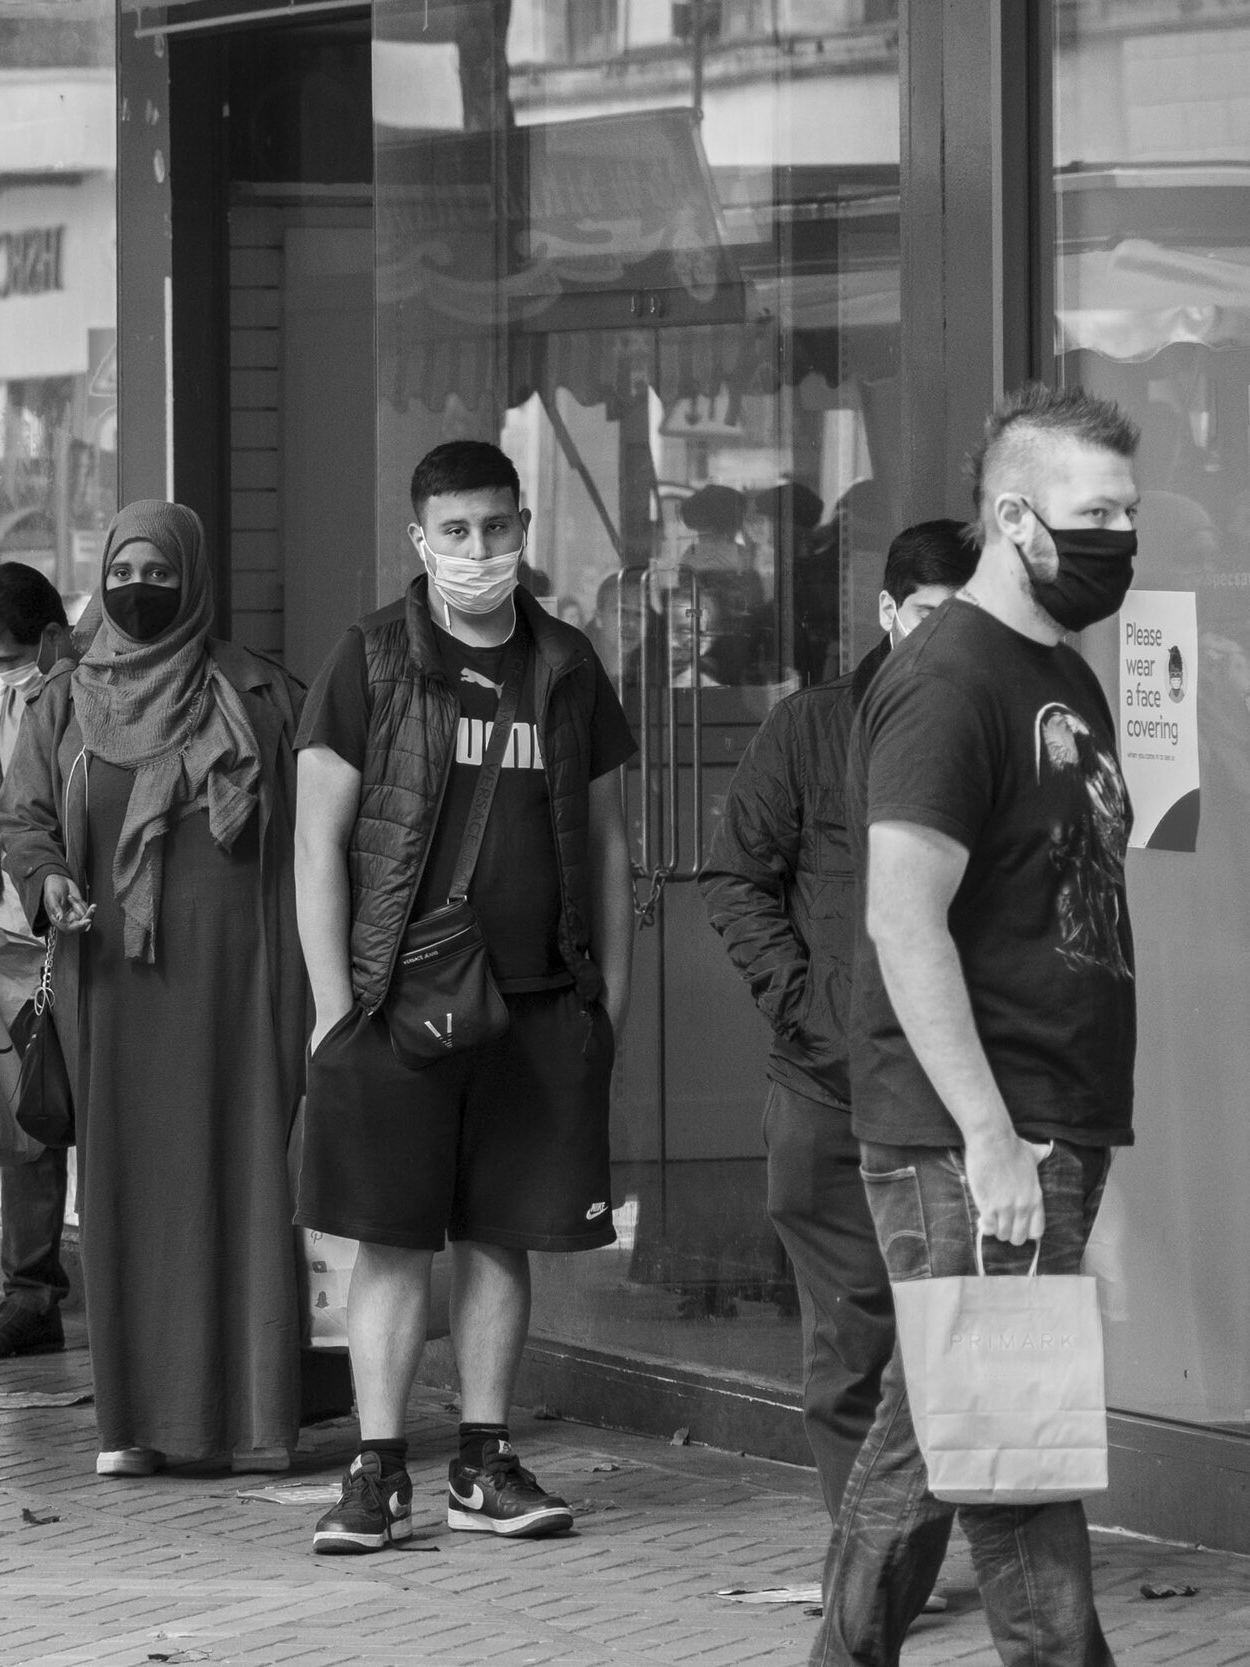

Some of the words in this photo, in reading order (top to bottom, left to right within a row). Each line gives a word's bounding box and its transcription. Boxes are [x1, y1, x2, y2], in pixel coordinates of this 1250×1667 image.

[1206, 572, 1250, 589] specsa
[1126, 622, 1163, 647] Please
[1126, 658, 1155, 677] wear
[1126, 689, 1134, 706] a
[1136, 683, 1161, 707] face
[1126, 715, 1179, 746] covering
[456, 717, 544, 770] UM
[466, 761, 500, 849] VERSACE
[948, 1332, 1075, 1351] PRIMARK
